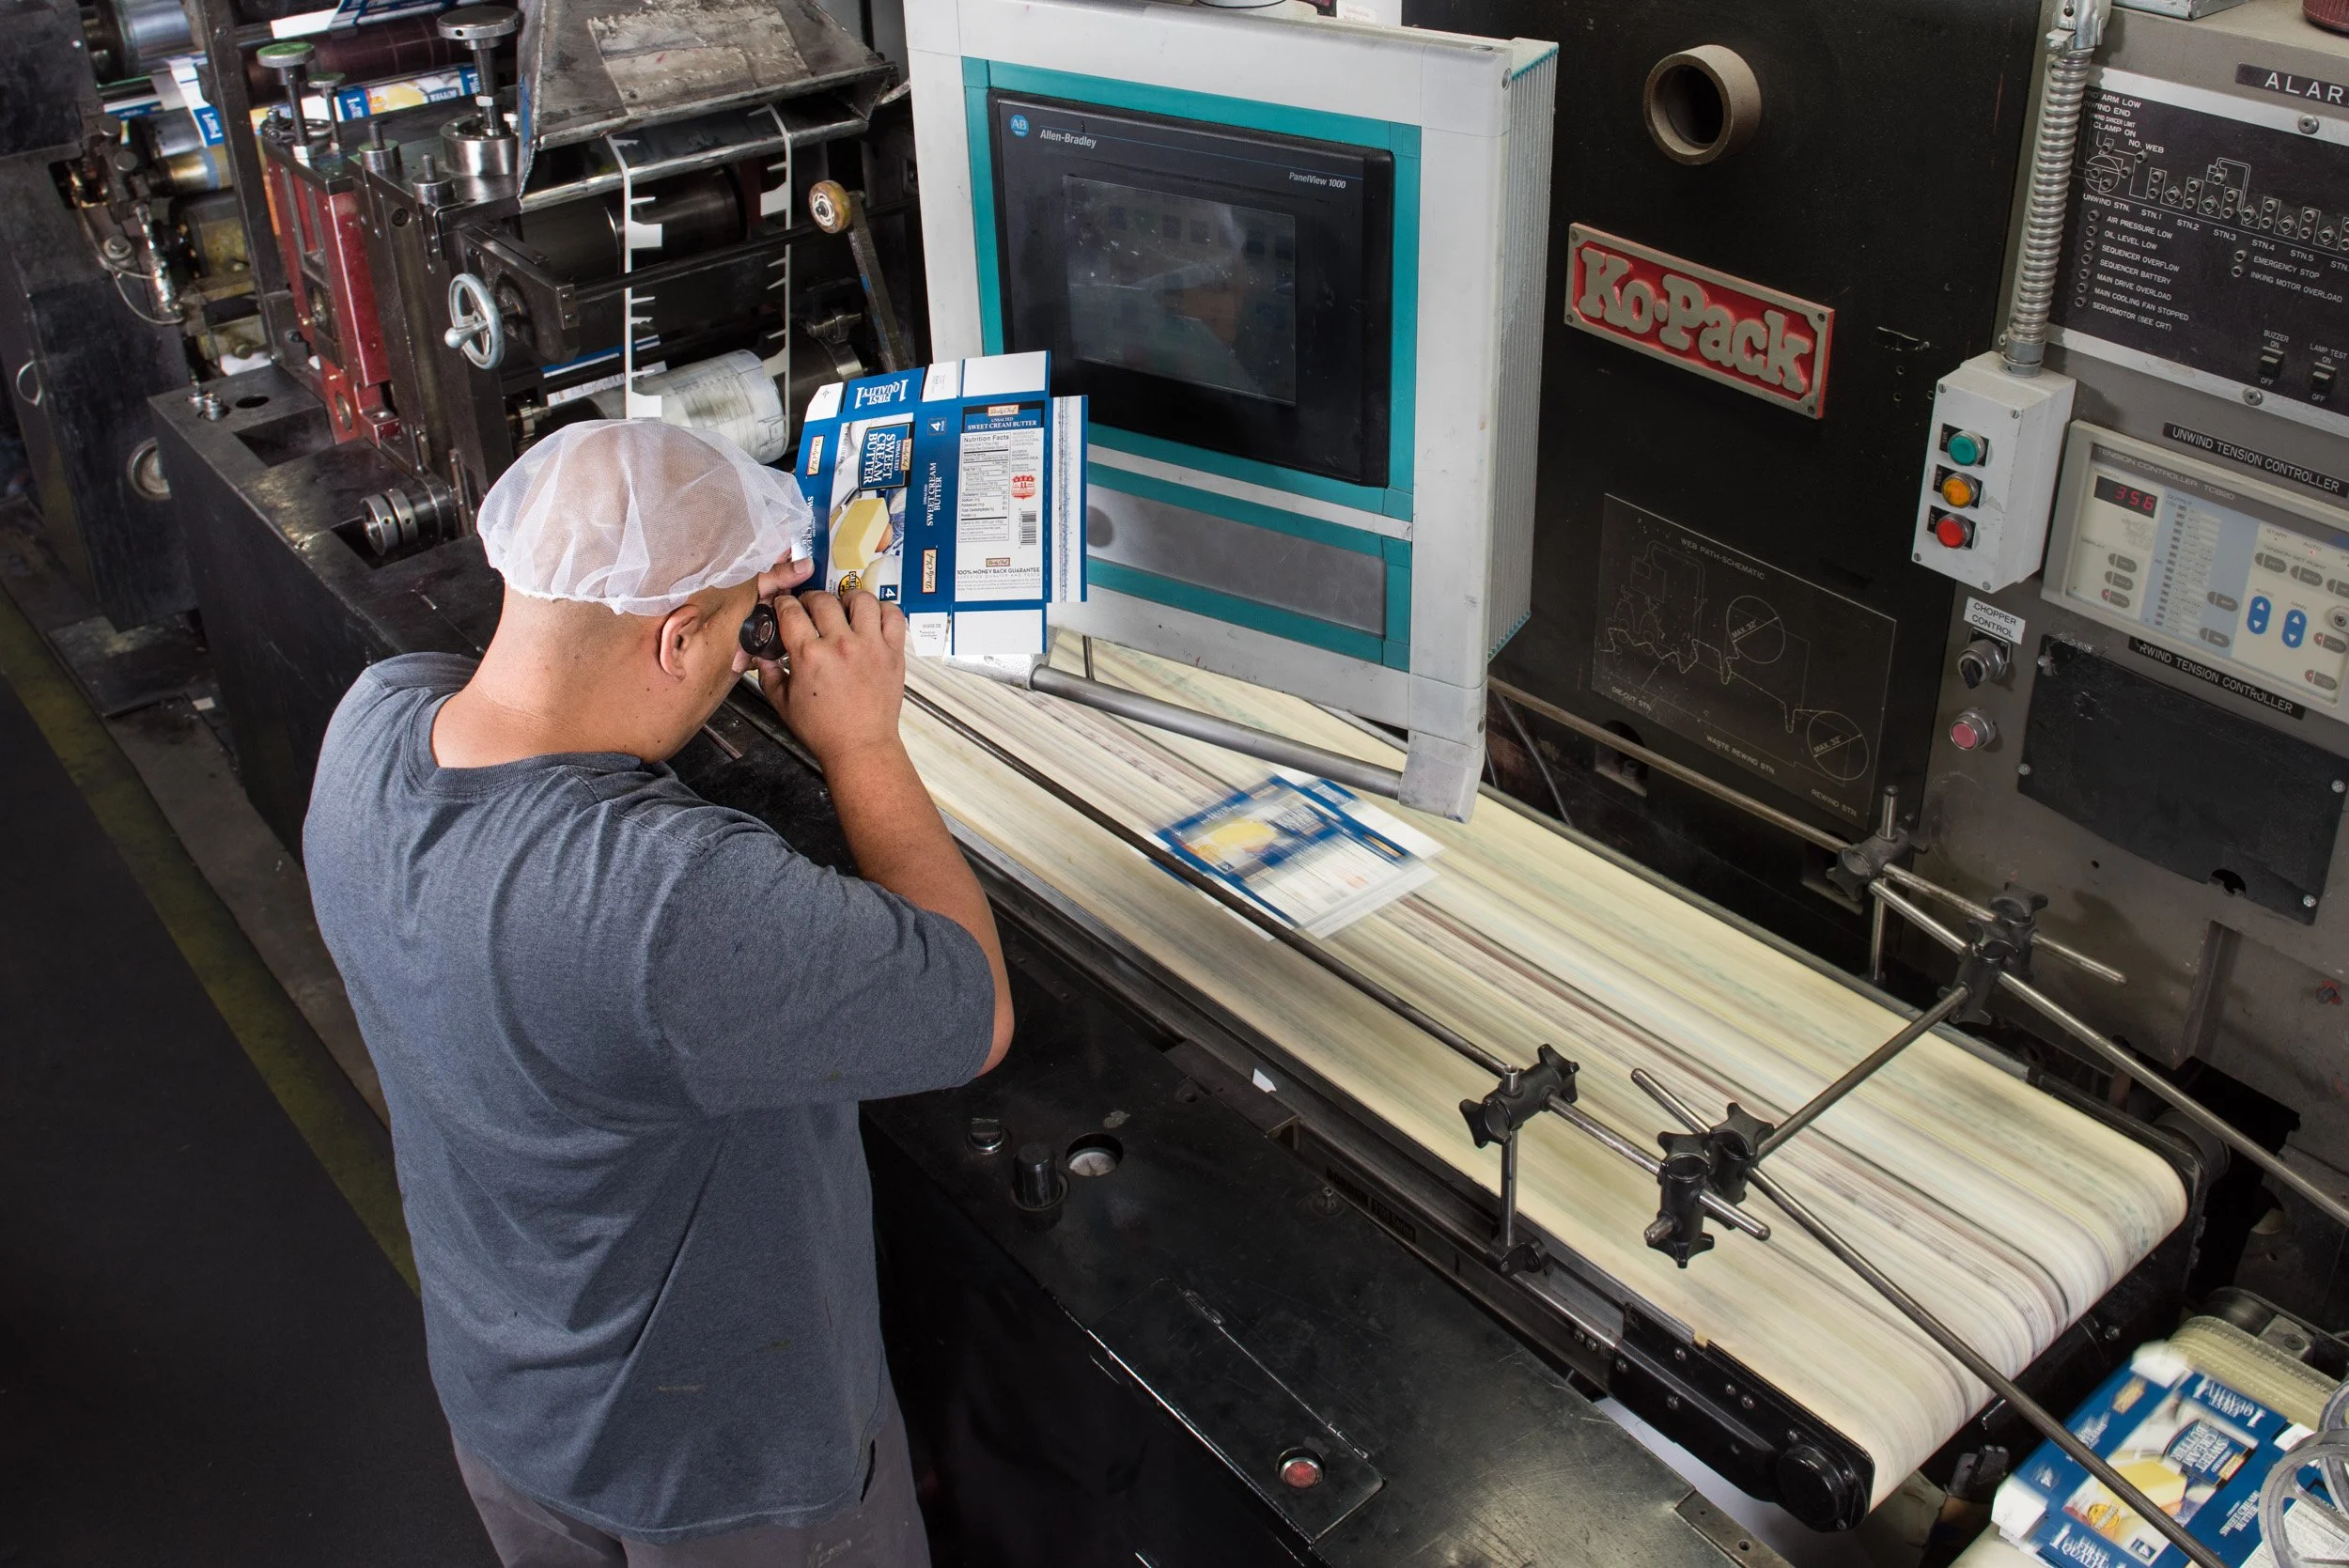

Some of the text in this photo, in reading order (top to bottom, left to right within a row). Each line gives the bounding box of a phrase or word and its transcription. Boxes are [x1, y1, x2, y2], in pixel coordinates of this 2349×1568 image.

[2264, 71, 2349, 105] ALAR
[2102, 94, 2120, 104] ARM
[2122, 99, 2141, 108] LOW
[2113, 107, 2131, 117] END
[1014, 119, 1026, 130] AB
[2093, 121, 2122, 132] CLAMP
[1040, 130, 1097, 148] Allen-Bradley
[2145, 143, 2164, 153] WEB
[1289, 172, 1346, 189] PanelView 1000
[2083, 194, 2130, 212] UNWIND STN.
[2107, 216, 2173, 240] AIR PRESSURE LOW
[2176, 219, 2200, 231] STN.2
[2213, 228, 2237, 241] STN.3
[2105, 230, 2157, 251] OIL LEVEL LOW
[2251, 239, 2276, 251] STN.4
[2102, 244, 2180, 272] SEQUENCER OVERFLOW
[2290, 249, 2314, 262] STN.5
[2099, 258, 2171, 286] SEQUENCER BATTERY
[2253, 256, 2320, 279] EMERGENCY STOP
[2096, 272, 2172, 302] MAIN DRIVE OVERLOAD
[2250, 272, 2343, 303] INKING MOTOR OVERLOAD
[2094, 287, 2189, 321] MAIN COOLING FAN STOPPED
[2092, 302, 2137, 320] SERVOMOTOR
[2138, 315, 2154, 326] (SEE
[2263, 329, 2290, 343] BUZZER
[2270, 340, 2280, 349] ON
[2310, 342, 2348, 360] LAMP TEST
[2322, 356, 2332, 365] ON
[862, 381, 900, 397] QUALITY
[2260, 377, 2274, 387] OFF
[866, 393, 892, 406] FIRST
[2311, 393, 2326, 403] OFF
[931, 422, 941, 431] 4
[863, 433, 879, 485] BUTTER
[873, 433, 887, 482] CREAM
[883, 433, 896, 479] SWEET
[2172, 427, 2340, 493] UNWIND TENSION CONTROLLER
[2098, 448, 2136, 467] TENSION
[2138, 461, 2198, 488] CONTROLLER
[926, 462, 937, 526] SWEET CREAM
[934, 476, 942, 511] BUTTER
[2115, 486, 2155, 511] 356
[926, 552, 935, 569] Chef
[1680, 537, 1766, 580] WEB PATH-SCHEMATIC
[885, 588, 896, 598] 4
[1973, 601, 2016, 627] CHOPPER
[1971, 613, 2014, 639] CONTROL
[2176, 658, 2219, 683] TENSION
[2223, 676, 2293, 714] CONTROLLER
[1706, 734, 1730, 752] WASTE
[1732, 747, 1758, 766] REWIND
[1812, 788, 1840, 807] REWIND
